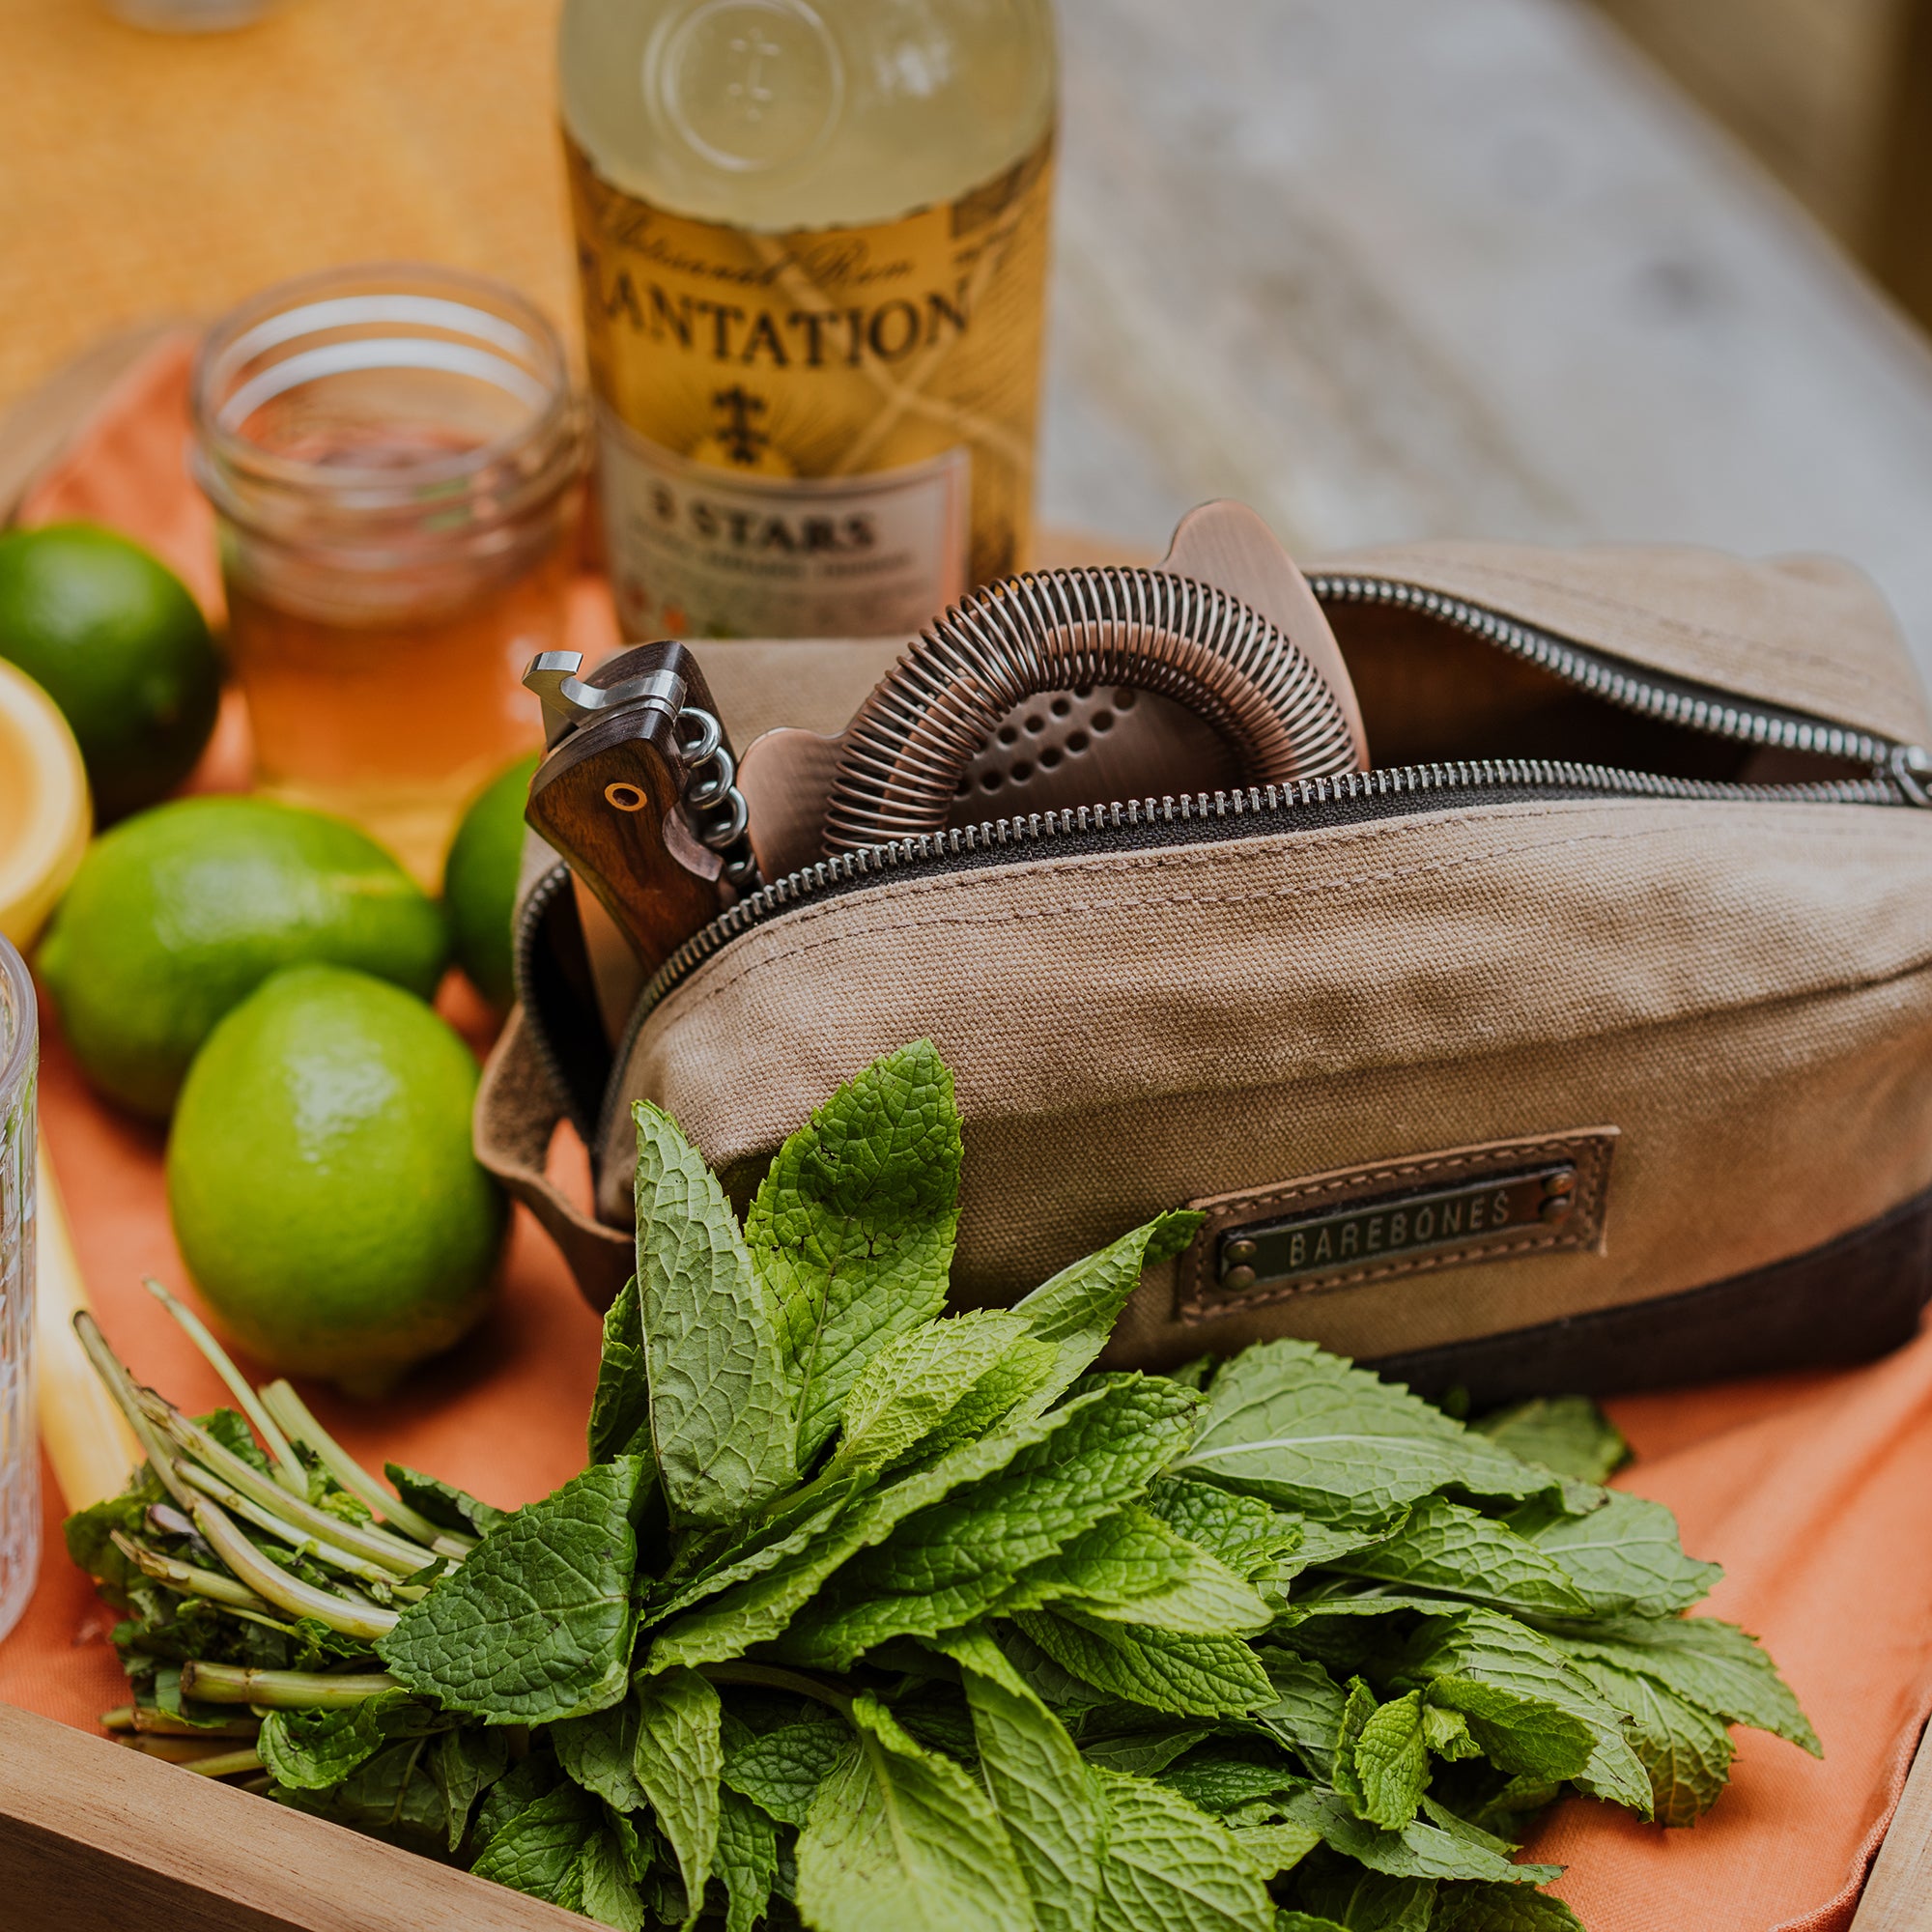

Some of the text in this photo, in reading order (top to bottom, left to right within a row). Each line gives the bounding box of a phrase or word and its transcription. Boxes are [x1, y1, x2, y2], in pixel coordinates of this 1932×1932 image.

[601, 269, 970, 366] ANTATION
[689, 500, 877, 554] STARS
[1289, 1189, 1511, 1267] BAREBONES
